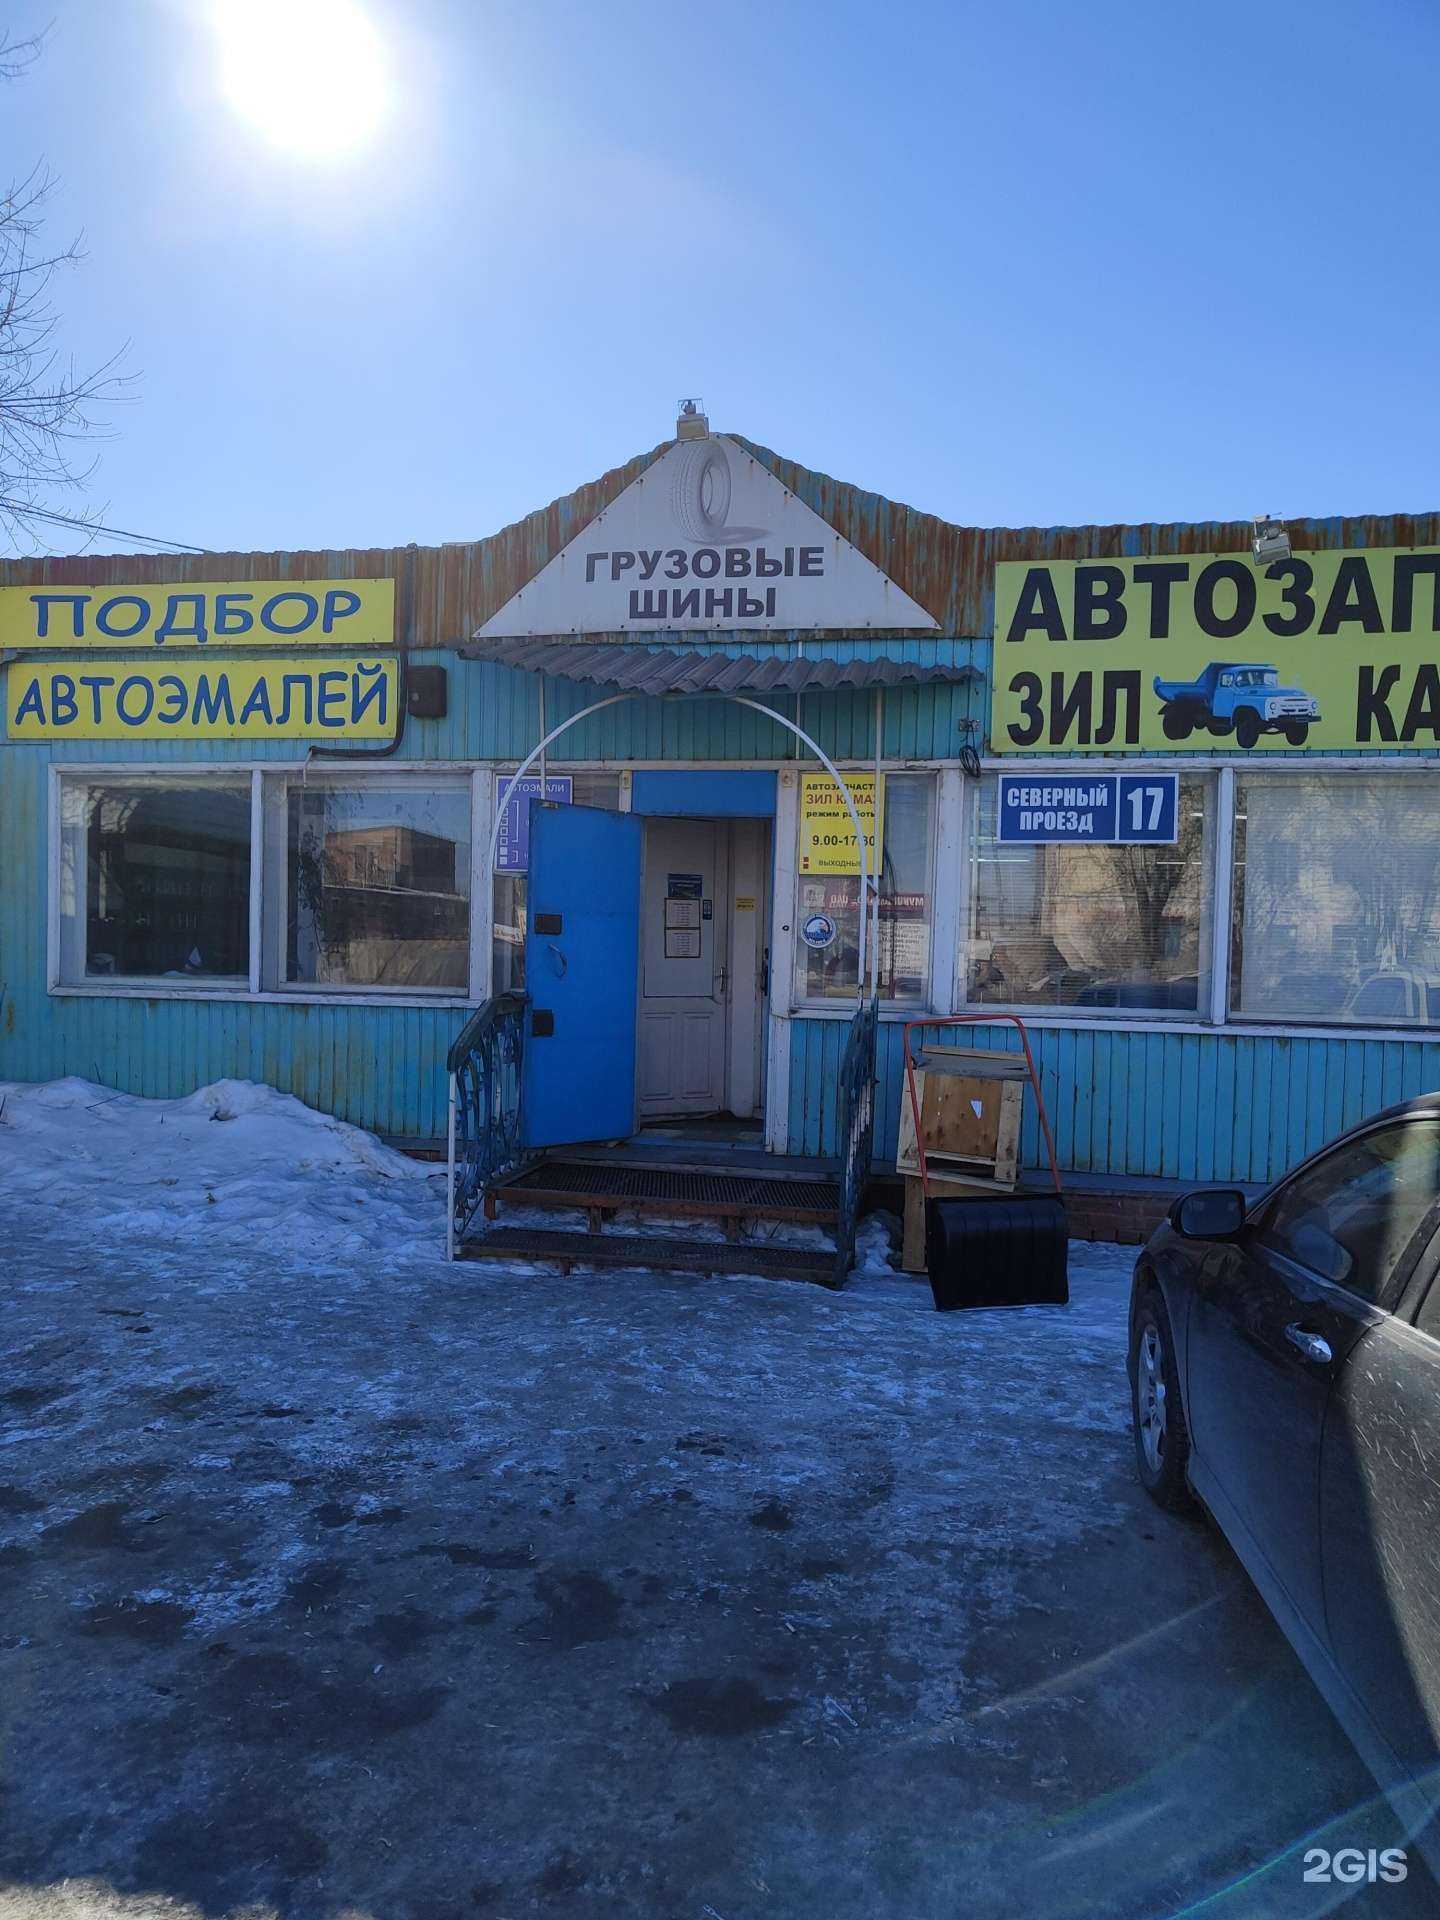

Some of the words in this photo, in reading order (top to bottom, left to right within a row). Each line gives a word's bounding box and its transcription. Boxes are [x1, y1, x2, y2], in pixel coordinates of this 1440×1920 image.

[585, 546, 825, 582] ГРУЗОВЫЕ
[628, 587, 777, 619] ШИНЫ
[1006, 553, 1440, 642] АВТОЗАП
[29, 590, 362, 644] ПОДБОР
[14, 662, 389, 728] АВТОЭМАЛЕЙ
[1007, 669, 1142, 747] ЗИЛ
[504, 783, 565, 793] АТОЭМАЛИ
[806, 793, 832, 805] ЗИЛ
[836, 793, 876, 805] КМА
[1006, 783, 1109, 808] СЕВЕРНЫЙ
[806, 810, 840, 819] режим
[1018, 809, 1094, 834] ПРОЕЗД
[1127, 786, 1164, 831] 17
